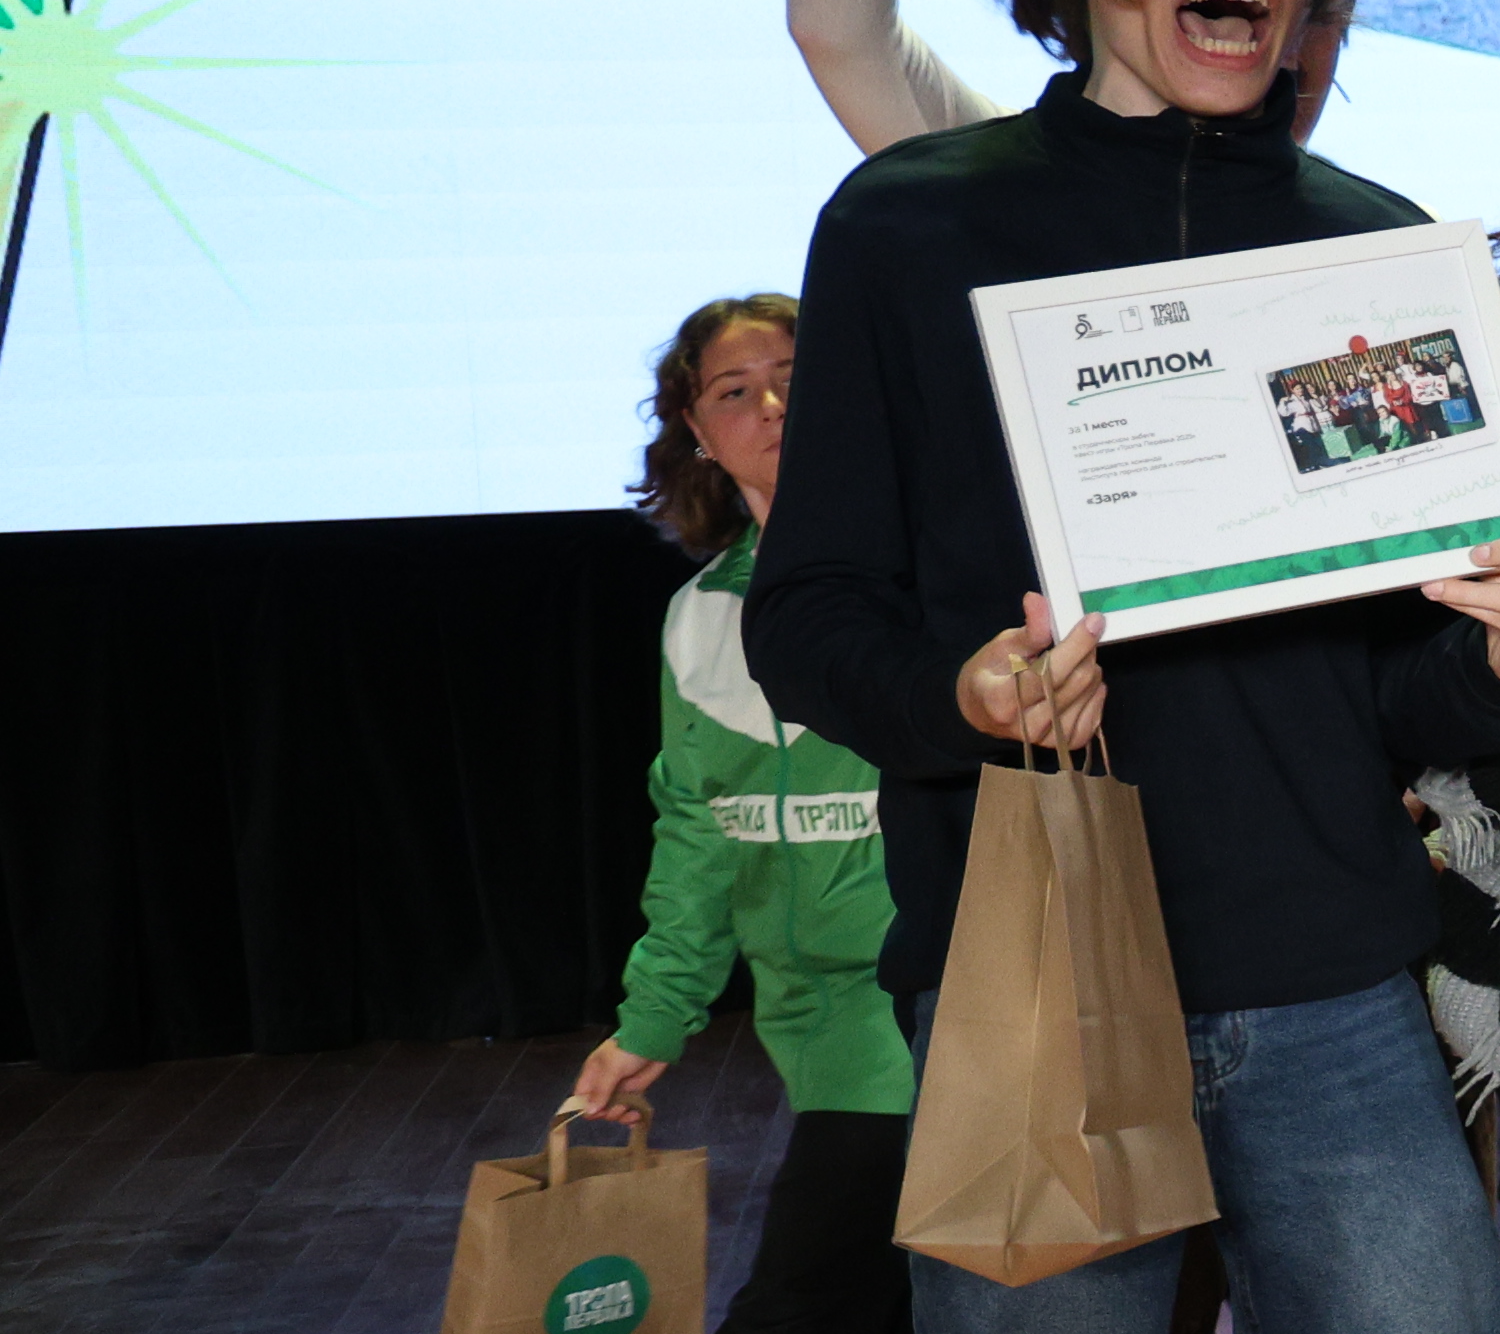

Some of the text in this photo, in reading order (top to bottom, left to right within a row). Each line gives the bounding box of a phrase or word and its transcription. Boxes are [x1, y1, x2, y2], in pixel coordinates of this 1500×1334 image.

[1150, 301, 1189, 318] ТРОПА
[1077, 348, 1213, 391] ДИПЛОМ
[1068, 418, 1128, 434] за 1 место
[1086, 490, 1138, 506] «Заря»
